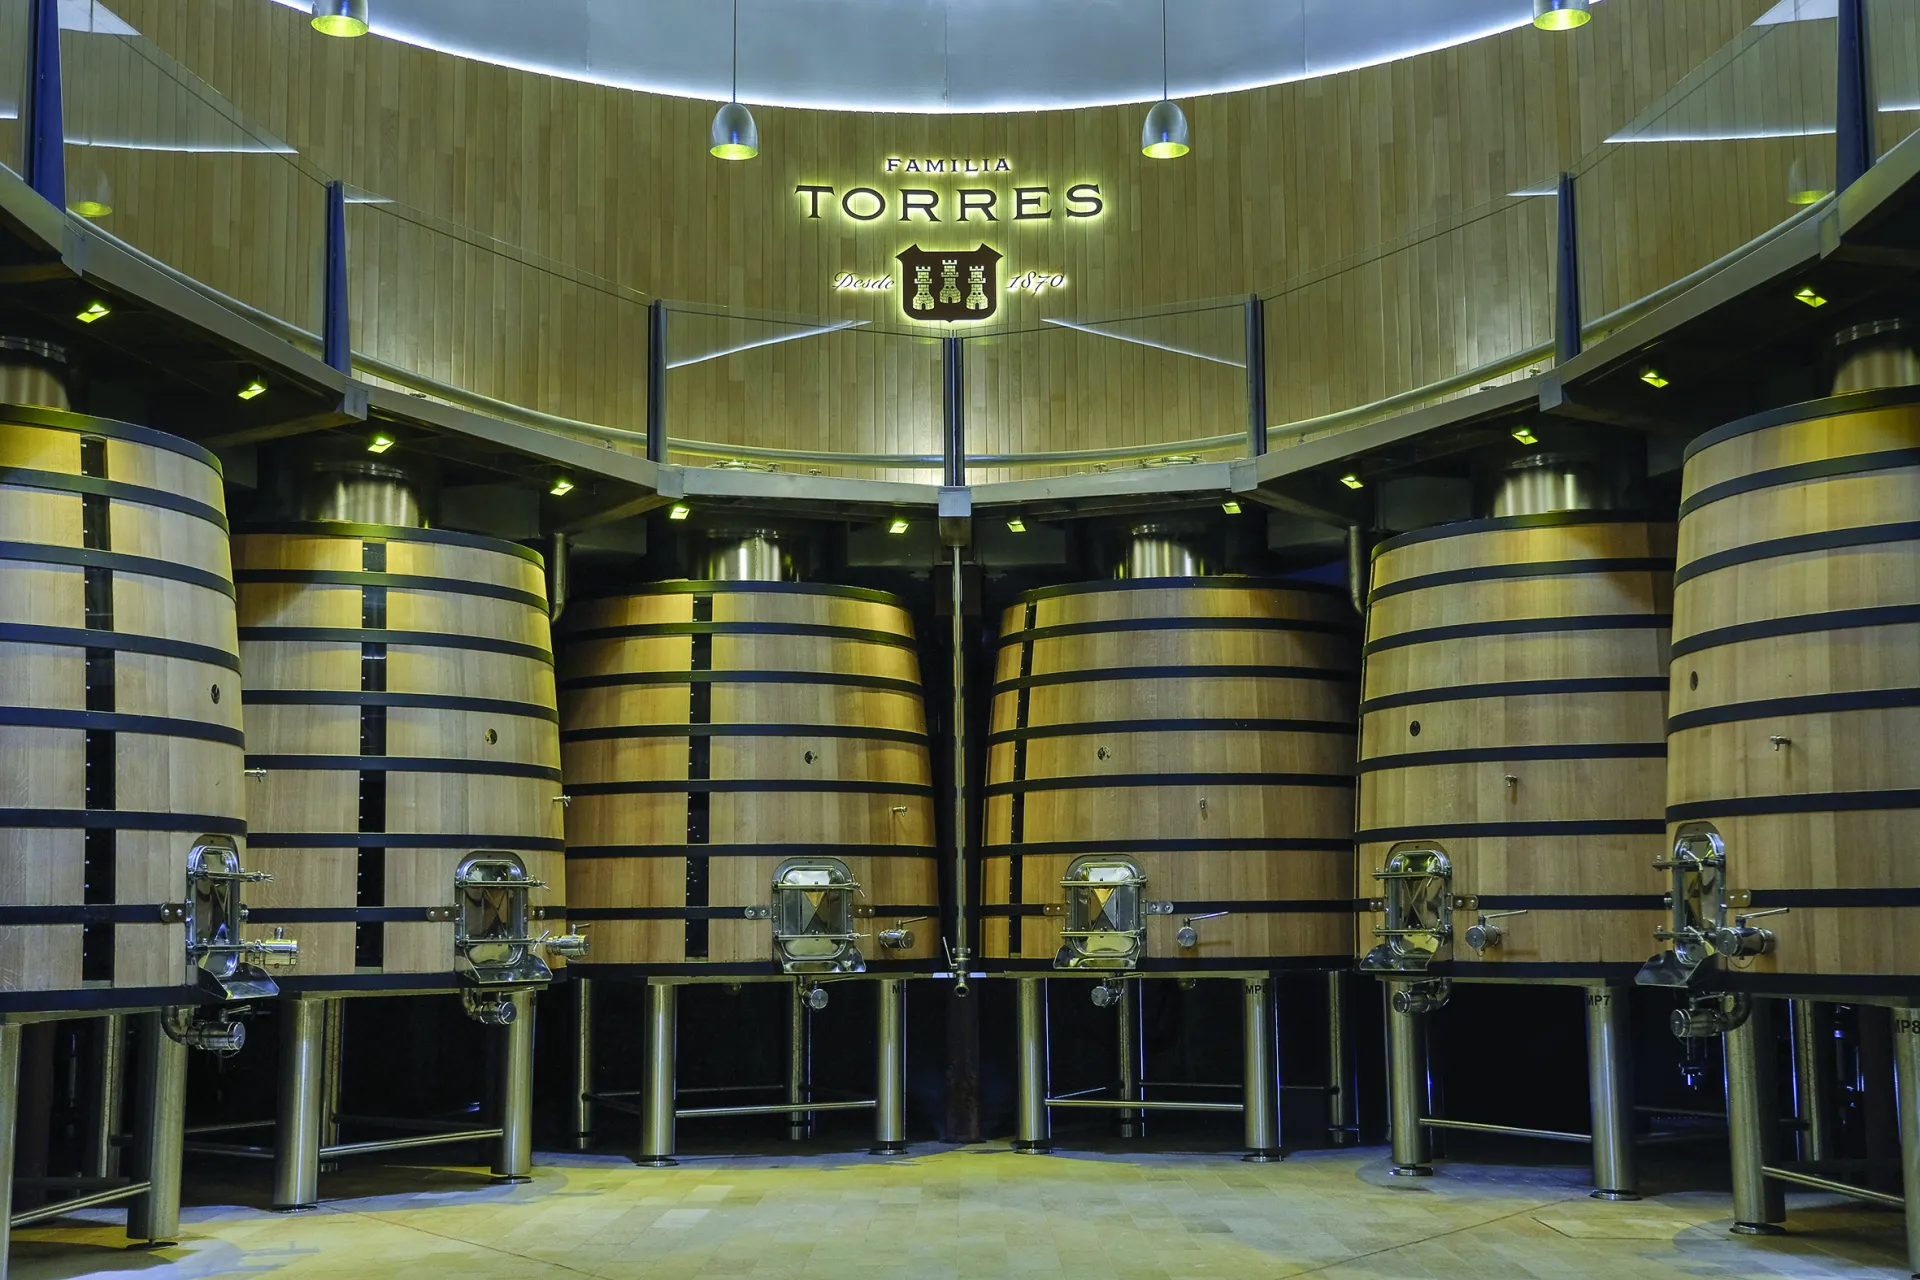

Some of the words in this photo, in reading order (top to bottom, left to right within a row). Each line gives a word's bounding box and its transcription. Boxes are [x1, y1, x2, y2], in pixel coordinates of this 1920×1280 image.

[886, 158, 1011, 173] FAMILIA
[795, 184, 1103, 222] TORRES
[832, 271, 895, 292] Desde
[1005, 271, 1065, 297] 1870
